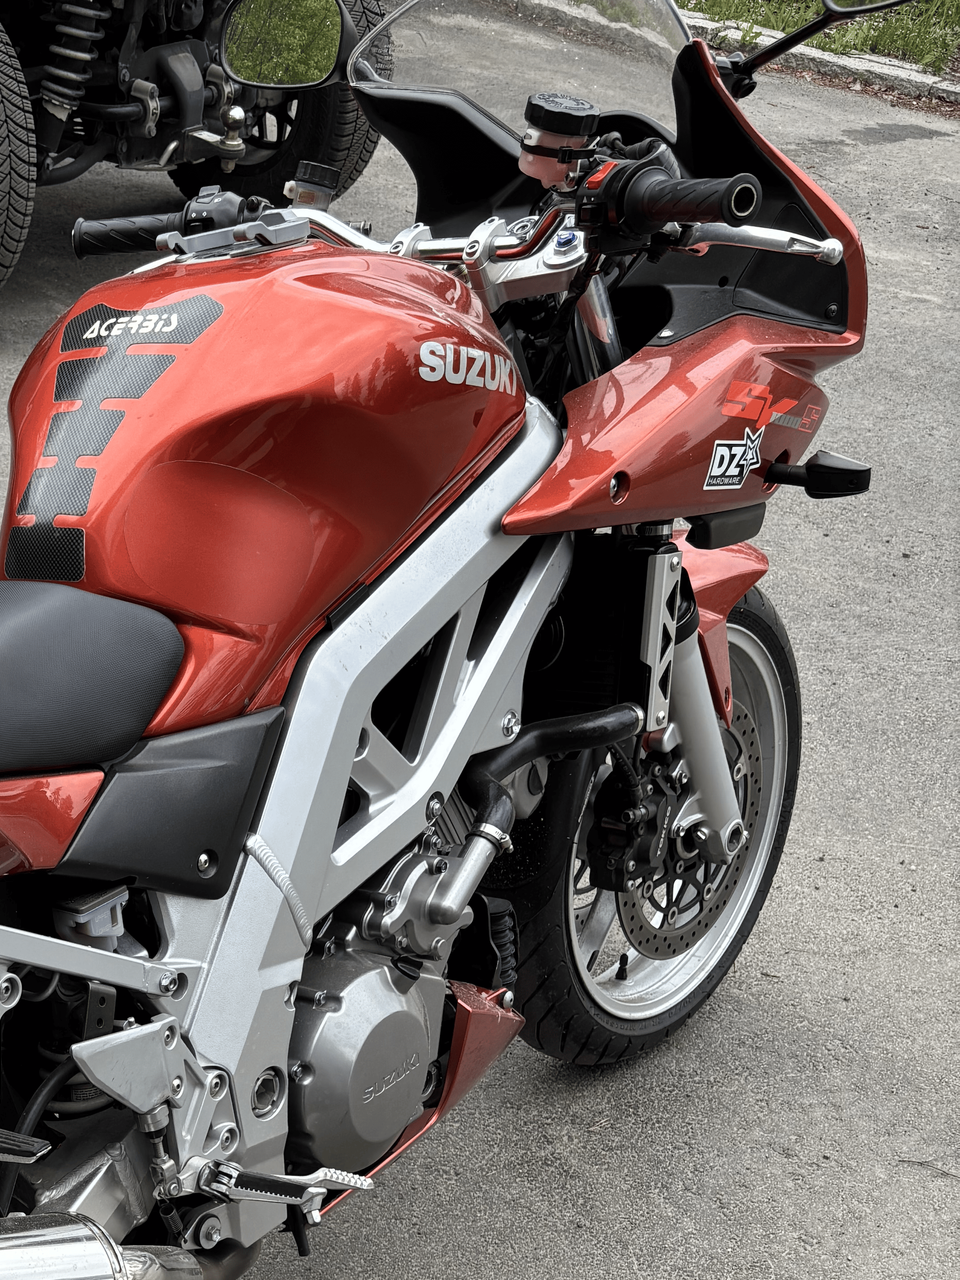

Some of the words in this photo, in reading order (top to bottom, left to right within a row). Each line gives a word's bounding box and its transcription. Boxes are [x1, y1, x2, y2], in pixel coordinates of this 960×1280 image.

[419, 341, 517, 396] SUZUKI
[707, 477, 740, 485] HARDWARE
[710, 446, 746, 476] DZ
[362, 1053, 421, 1104] SUZUKI
